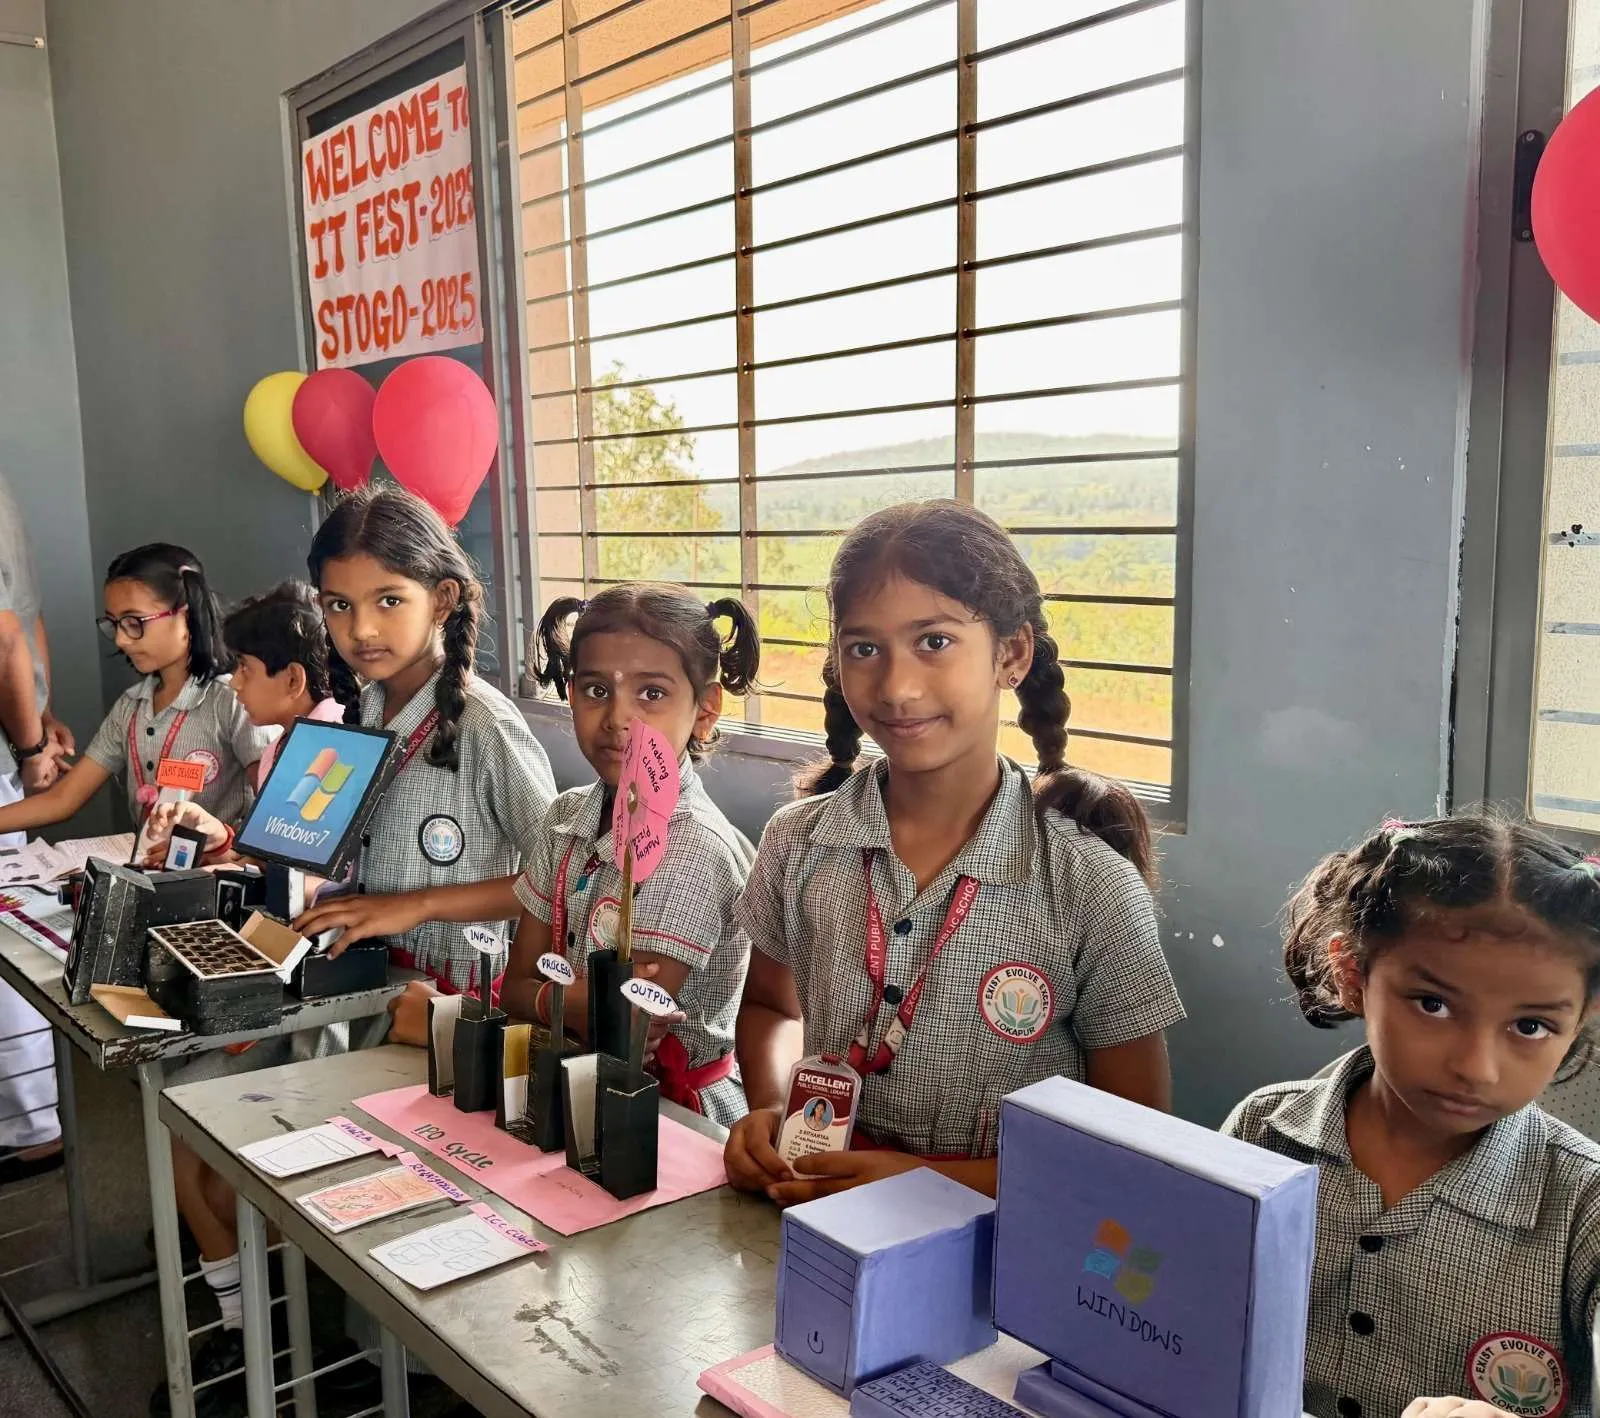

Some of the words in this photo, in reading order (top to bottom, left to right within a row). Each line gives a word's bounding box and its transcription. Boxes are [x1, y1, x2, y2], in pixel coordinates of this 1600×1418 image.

[305, 82, 443, 205] WELCOME
[310, 211, 347, 279] IT
[265, 816, 317, 845] Windows
[316, 830, 331, 848] 7
[955, 878, 978, 915] SCHOO
[470, 929, 495, 947] INPUT
[870, 912, 881, 951] PUBLIC
[541, 957, 573, 979] PROCESS
[630, 983, 672, 1008] OUTPUT
[985, 976, 1001, 1000] EXIST
[1006, 969, 1039, 983] EVOLVE
[1039, 982, 1048, 1011] EXCEL
[994, 1019, 1036, 1037] LOKAPUR
[798, 1072, 852, 1091] EXCELLENT
[1077, 1285, 1184, 1356] WINDOWS
[1475, 1346, 1496, 1375] EXIST
[1500, 1339, 1545, 1360] EVOLVE
[1546, 1358, 1561, 1390] EXCEL
[1490, 1394, 1548, 1416] LOKAPUR
